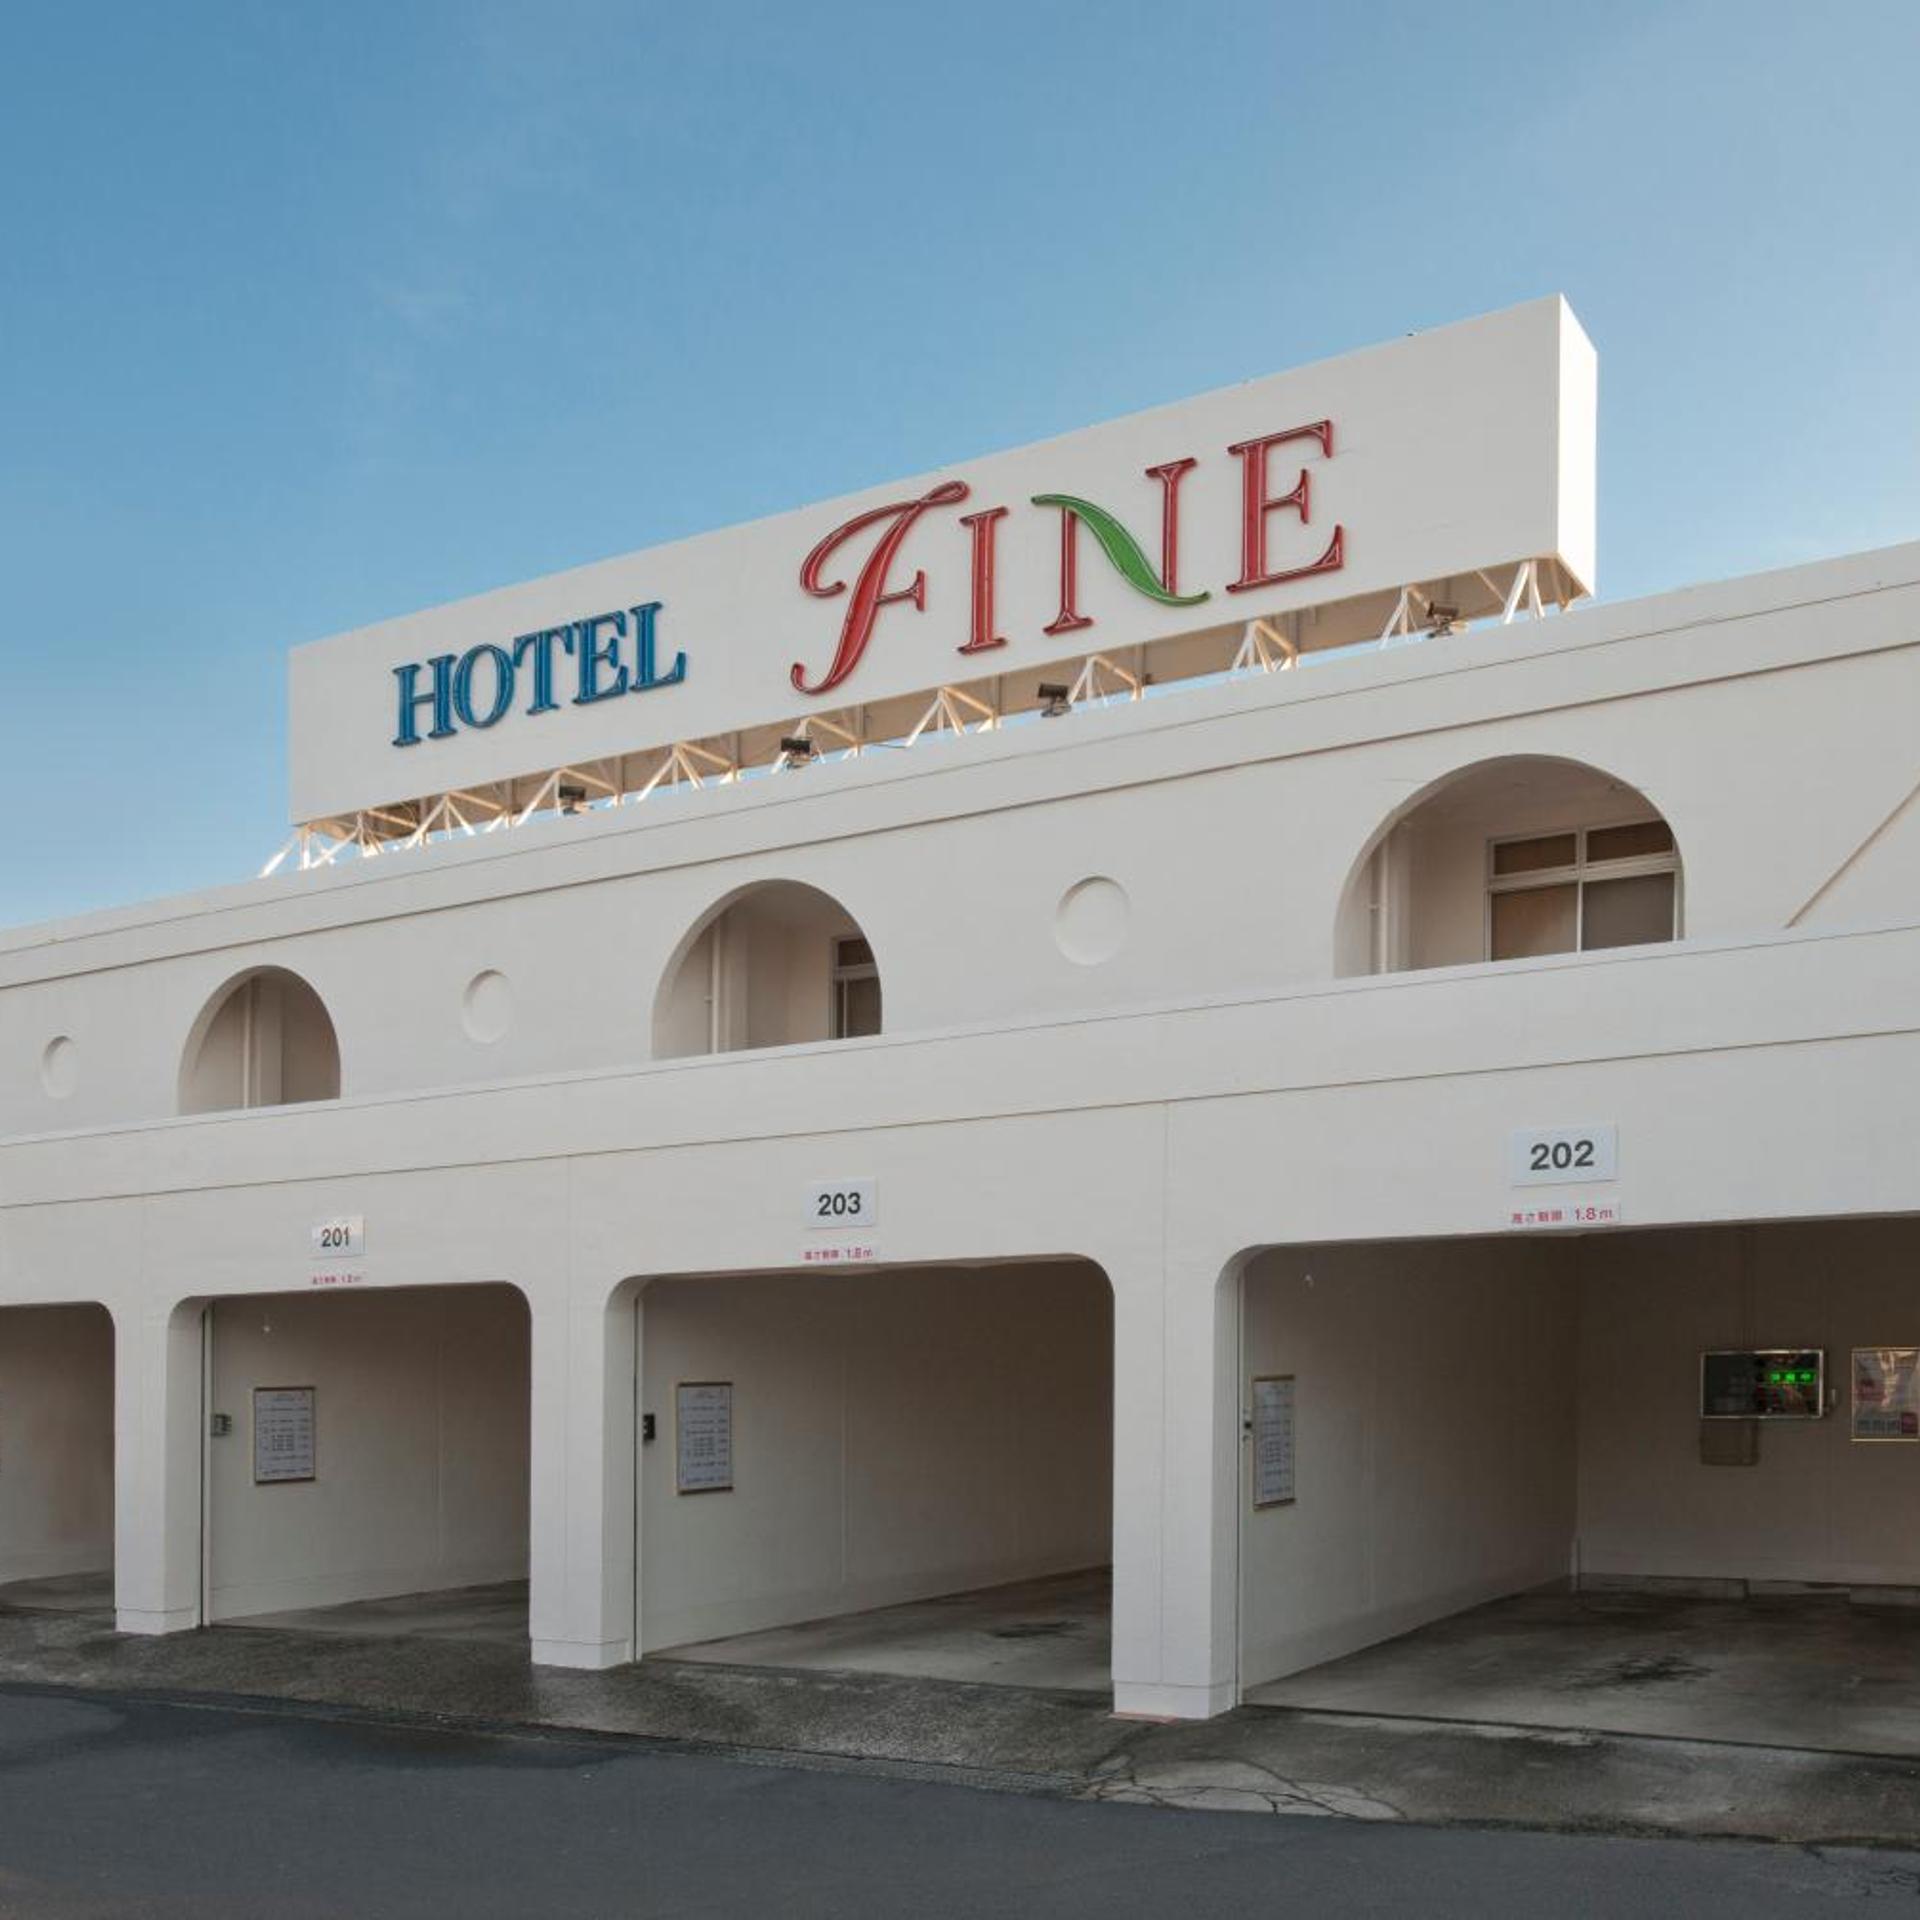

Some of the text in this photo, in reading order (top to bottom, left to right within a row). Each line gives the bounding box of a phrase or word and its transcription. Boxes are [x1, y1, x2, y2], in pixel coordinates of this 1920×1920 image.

[391, 419, 1345, 748] HOTEL FINE
[1530, 1140, 1595, 1171] 202
[818, 1192, 861, 1216] 203
[321, 1227, 351, 1248] 201
